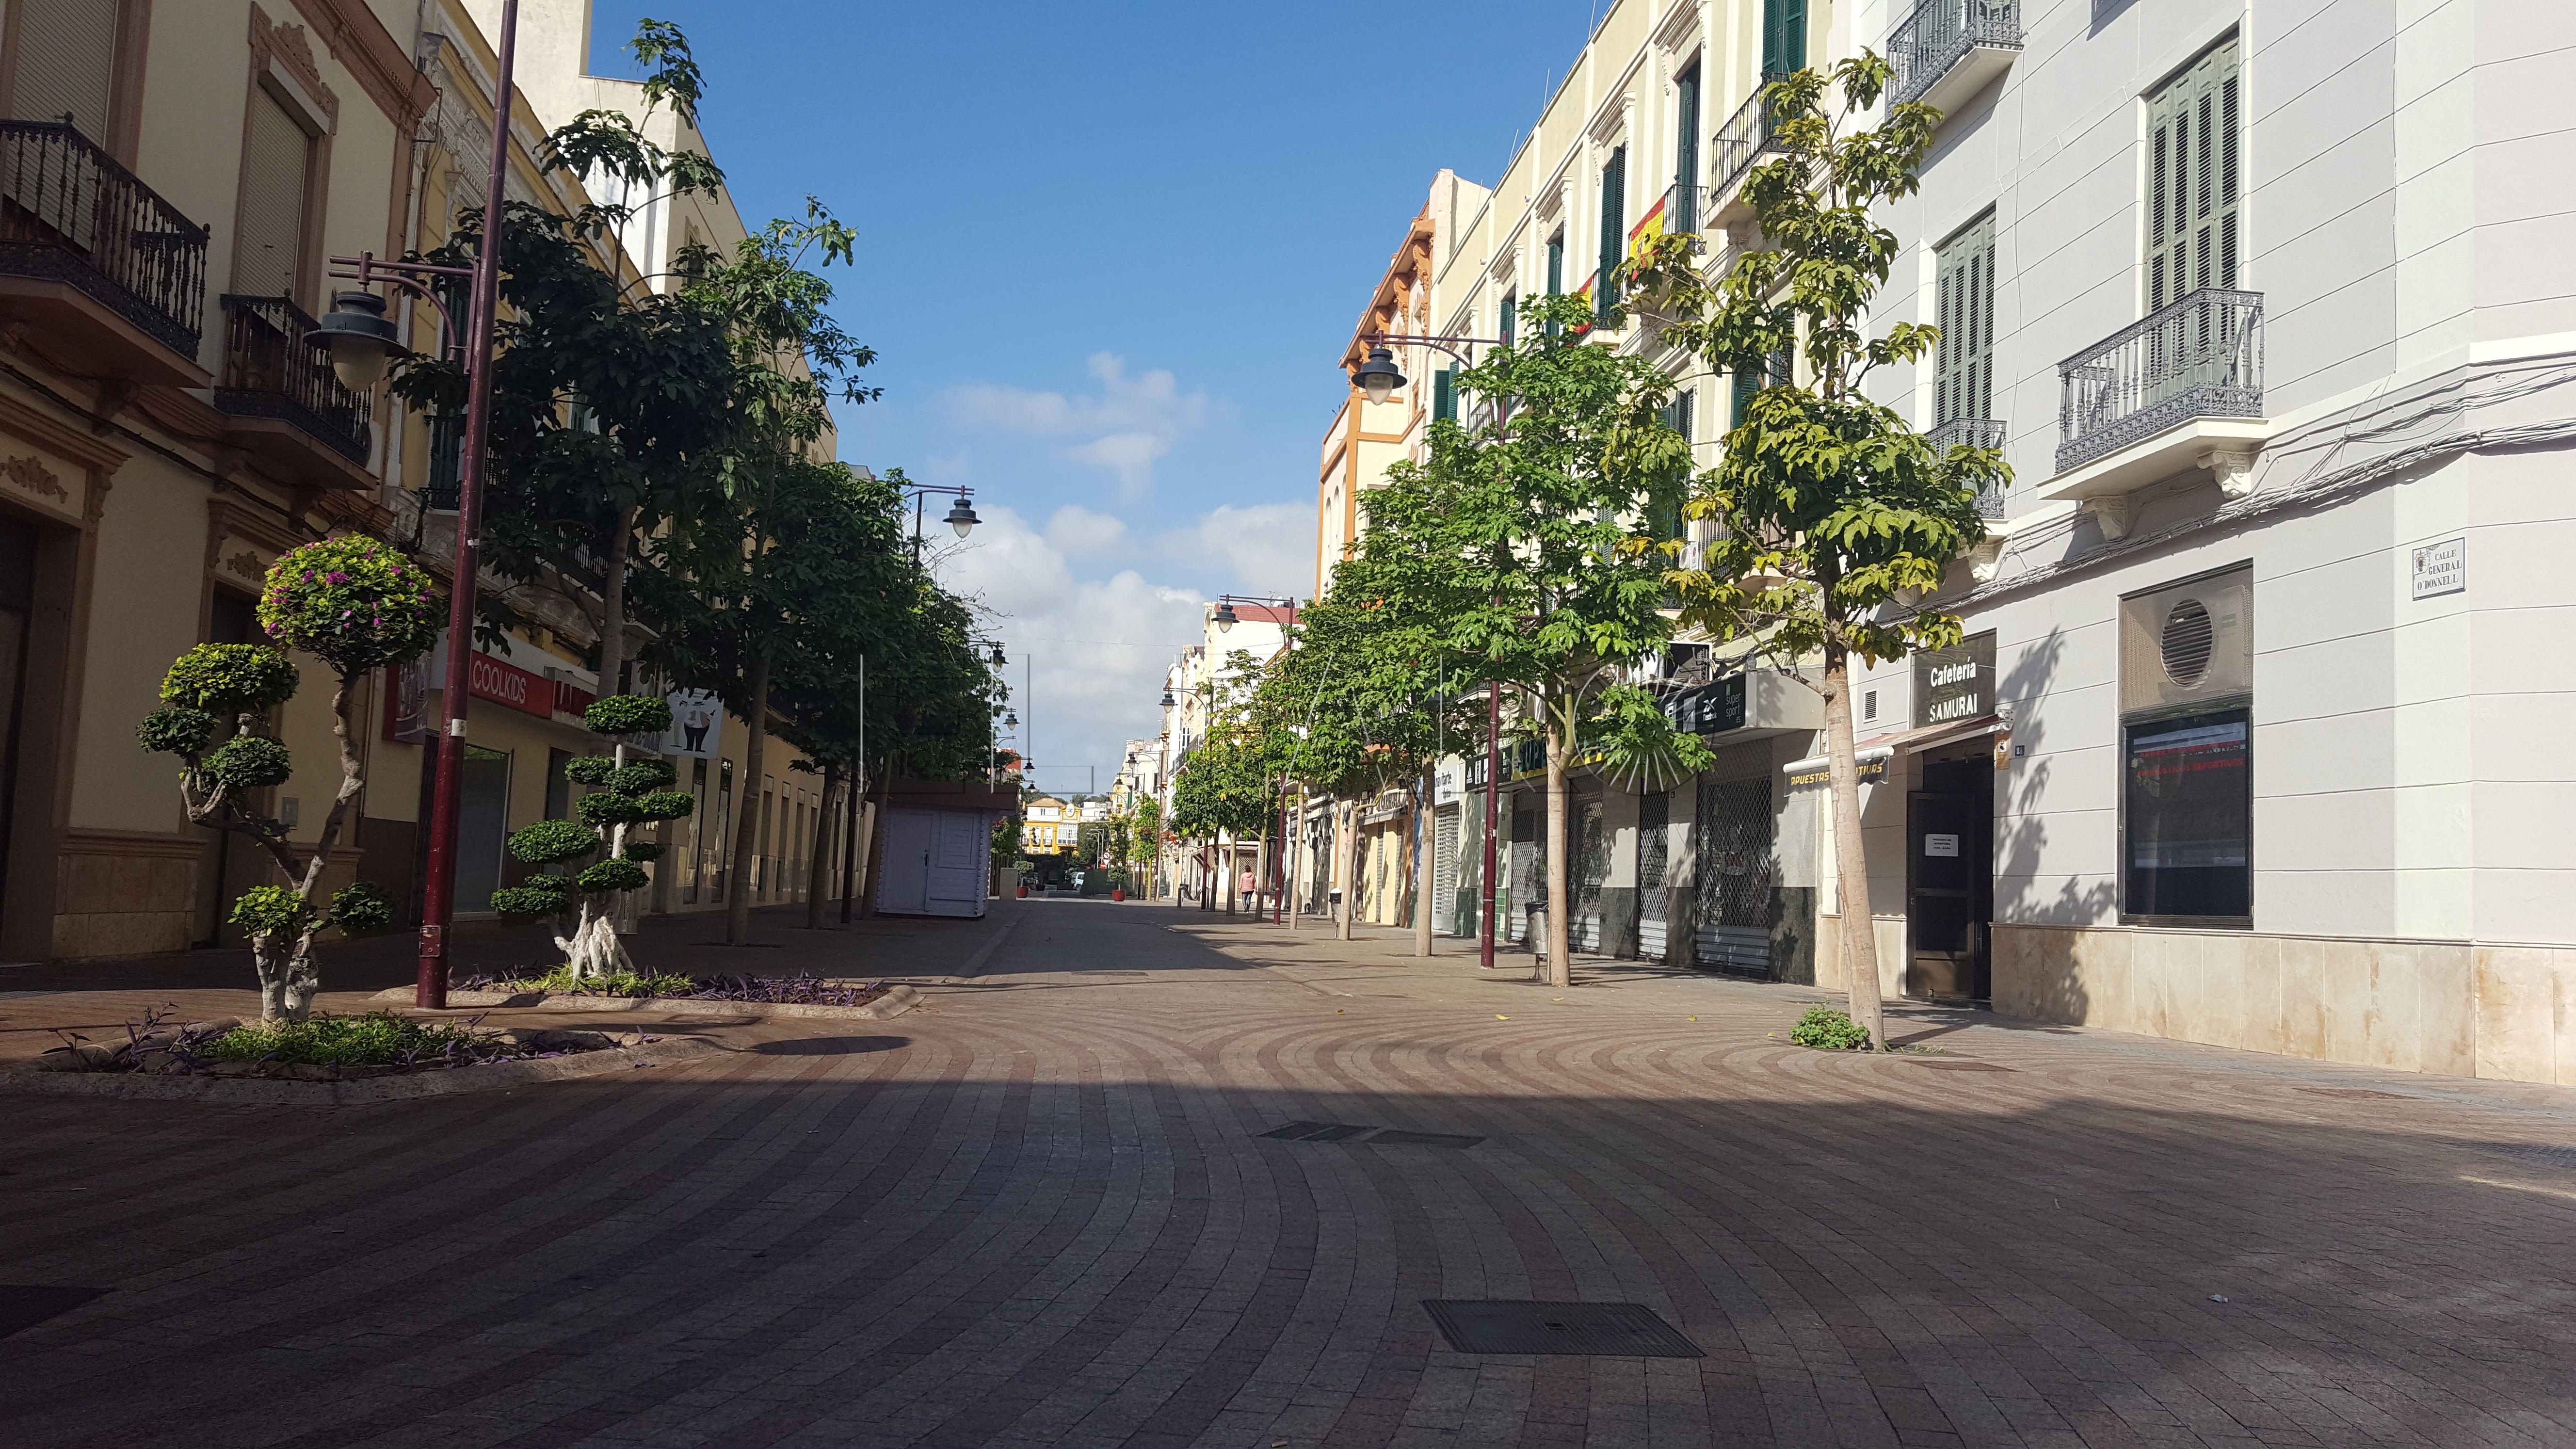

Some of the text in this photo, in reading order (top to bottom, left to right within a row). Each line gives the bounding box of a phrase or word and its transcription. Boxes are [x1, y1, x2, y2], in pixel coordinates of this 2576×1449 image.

[2435, 549, 2457, 561] CALLE
[2428, 560, 2463, 576] GENERAL
[2417, 574, 2459, 591] O'DONNELL
[1930, 656, 1977, 688] Cafetería
[473, 660, 526, 704] COOLKIDS
[1726, 692, 1741, 707] super
[1929, 693, 1978, 722] SAMURAI
[1725, 705, 1740, 720] sport
[1791, 772, 1830, 786] APUESTAS
